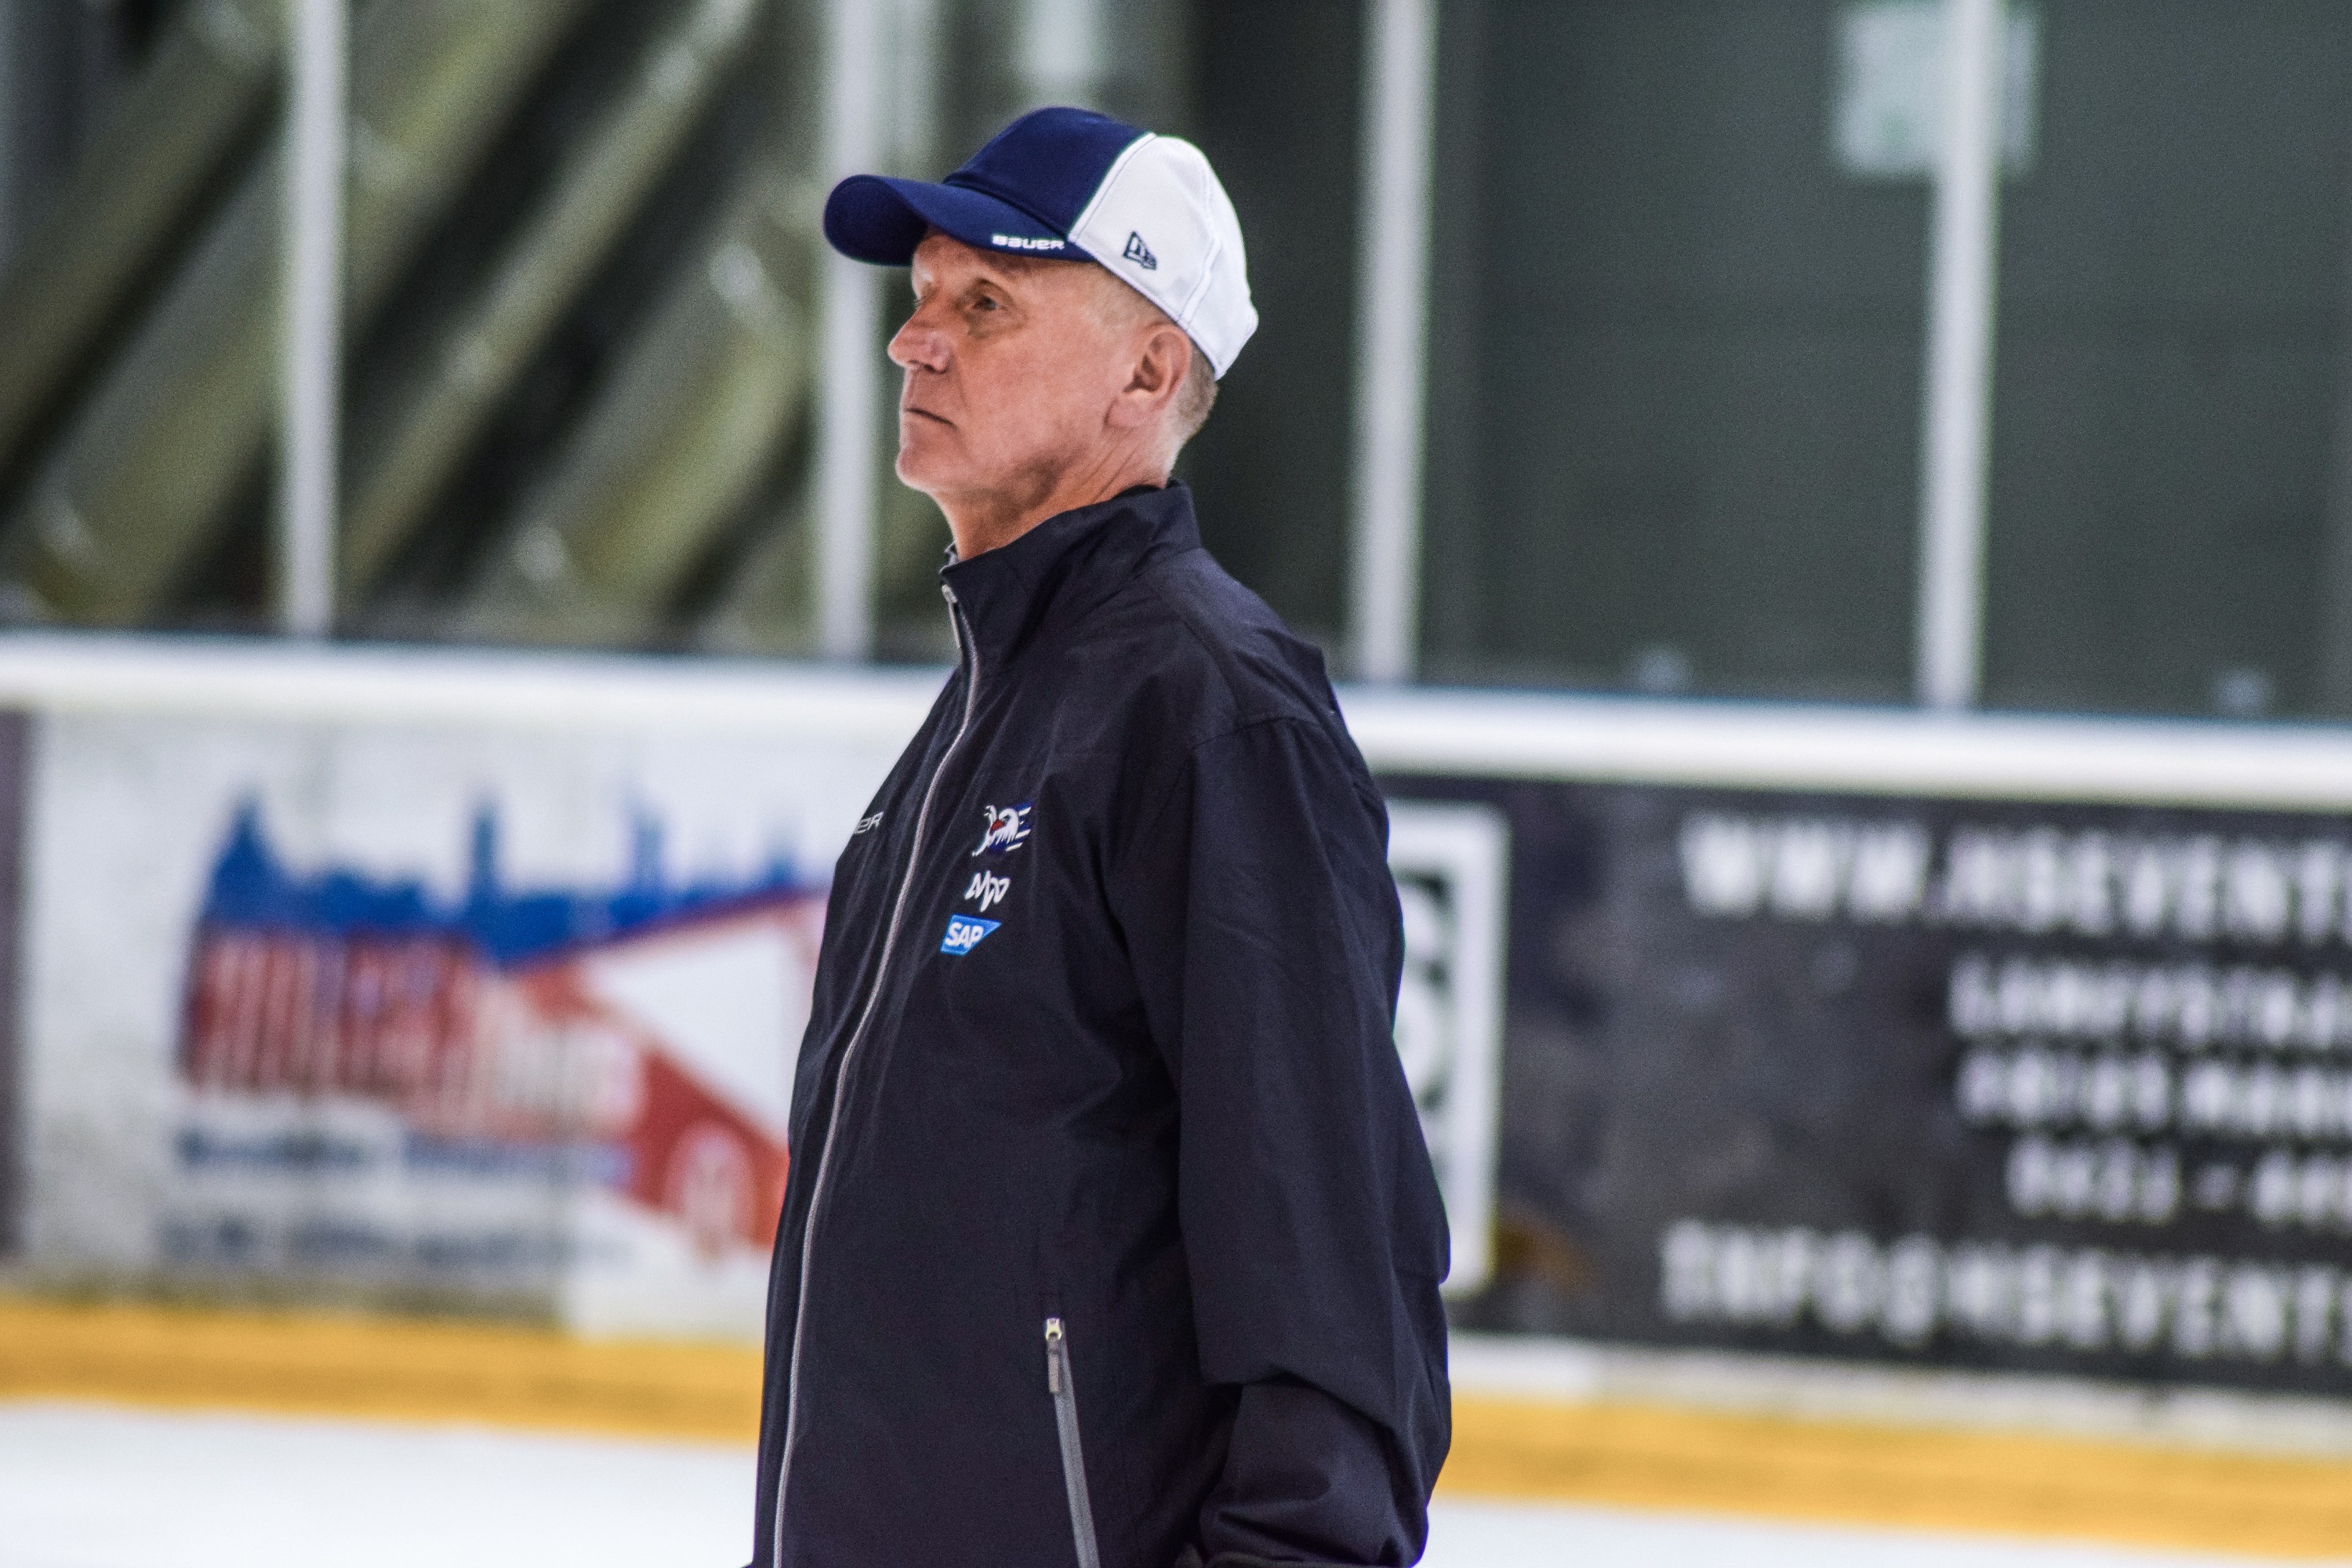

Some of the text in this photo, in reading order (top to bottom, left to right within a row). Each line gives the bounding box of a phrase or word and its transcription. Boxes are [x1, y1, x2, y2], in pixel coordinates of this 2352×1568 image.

[992, 234, 1065, 250] BAUER
[855, 811, 884, 835] ER
[944, 921, 984, 948] SAP
